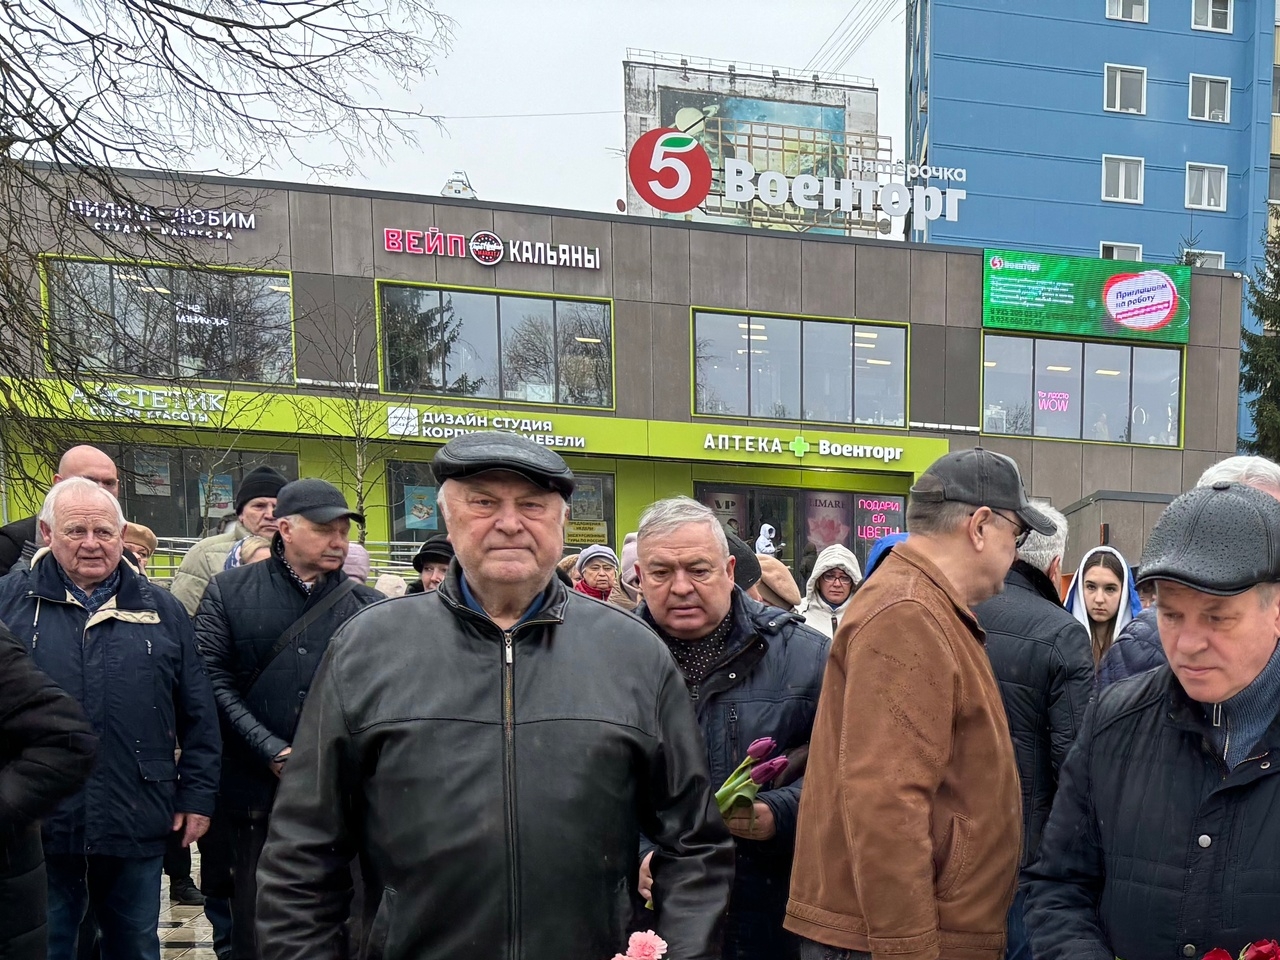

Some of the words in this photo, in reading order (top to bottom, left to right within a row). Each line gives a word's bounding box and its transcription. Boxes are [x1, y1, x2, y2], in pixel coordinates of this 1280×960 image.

[648, 132, 698, 200] 5
[848, 154, 966, 182] Пятёрочка
[724, 157, 966, 231] Военторг
[383, 226, 466, 258] ВЕЙП
[509, 239, 600, 270] КАЛЬЯНЫ
[1038, 398, 1069, 412] WOW
[422, 411, 488, 427] ДИЗАЙН
[492, 416, 553, 432] СТУДИЯ
[703, 433, 783, 453] АПТЕКА
[818, 439, 904, 463] Военторг
[858, 499, 899, 512] ПОДАРИ
[872, 512, 886, 524] ЕЙ
[857, 525, 900, 540] ЦВЕТЫ
